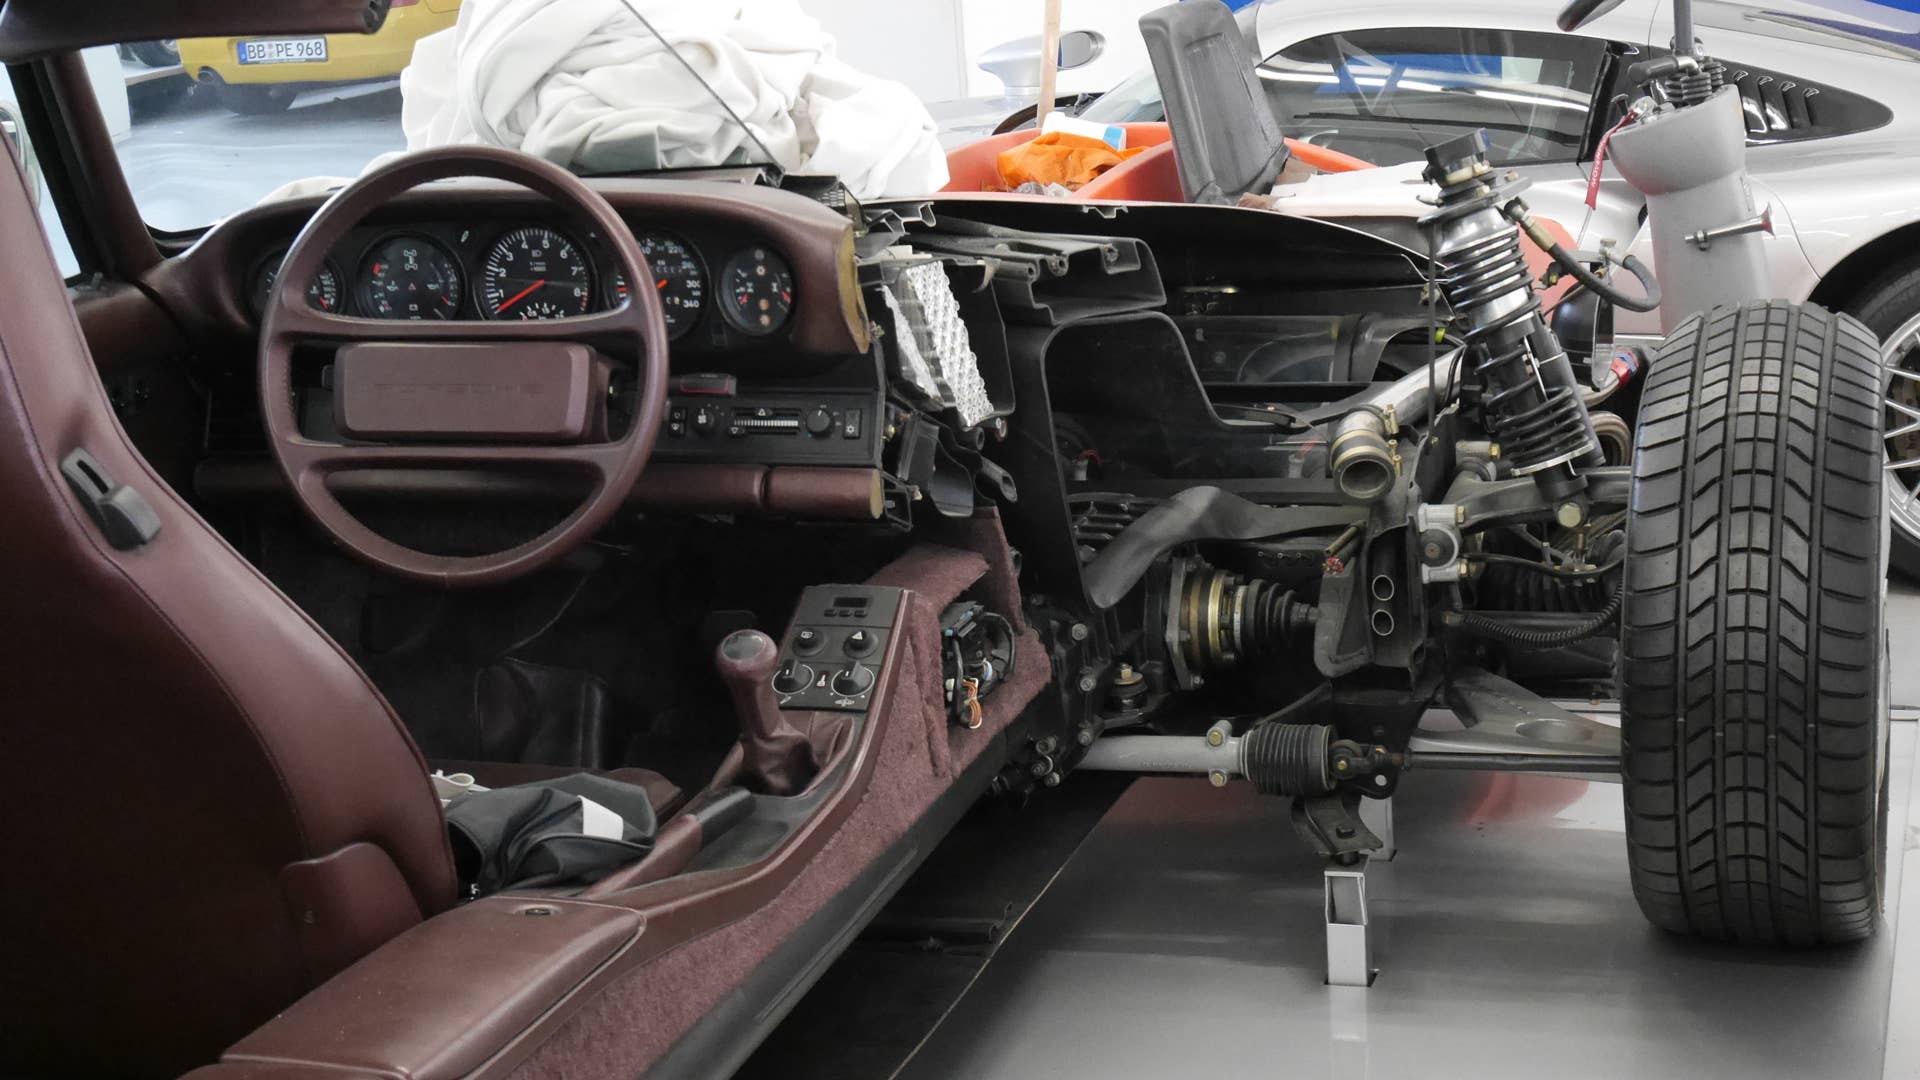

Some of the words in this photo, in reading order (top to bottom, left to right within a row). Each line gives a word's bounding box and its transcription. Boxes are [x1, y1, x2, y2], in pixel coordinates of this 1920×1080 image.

[247, 44, 265, 59] BB
[275, 43, 293, 57] PE
[296, 41, 323, 56] 968
[521, 240, 529, 249] 4
[542, 240, 550, 249] 5
[506, 251, 514, 262] 3
[560, 249, 568, 259] 6
[499, 267, 507, 278] 2
[571, 266, 578, 276] 7
[574, 288, 581, 297] 8
